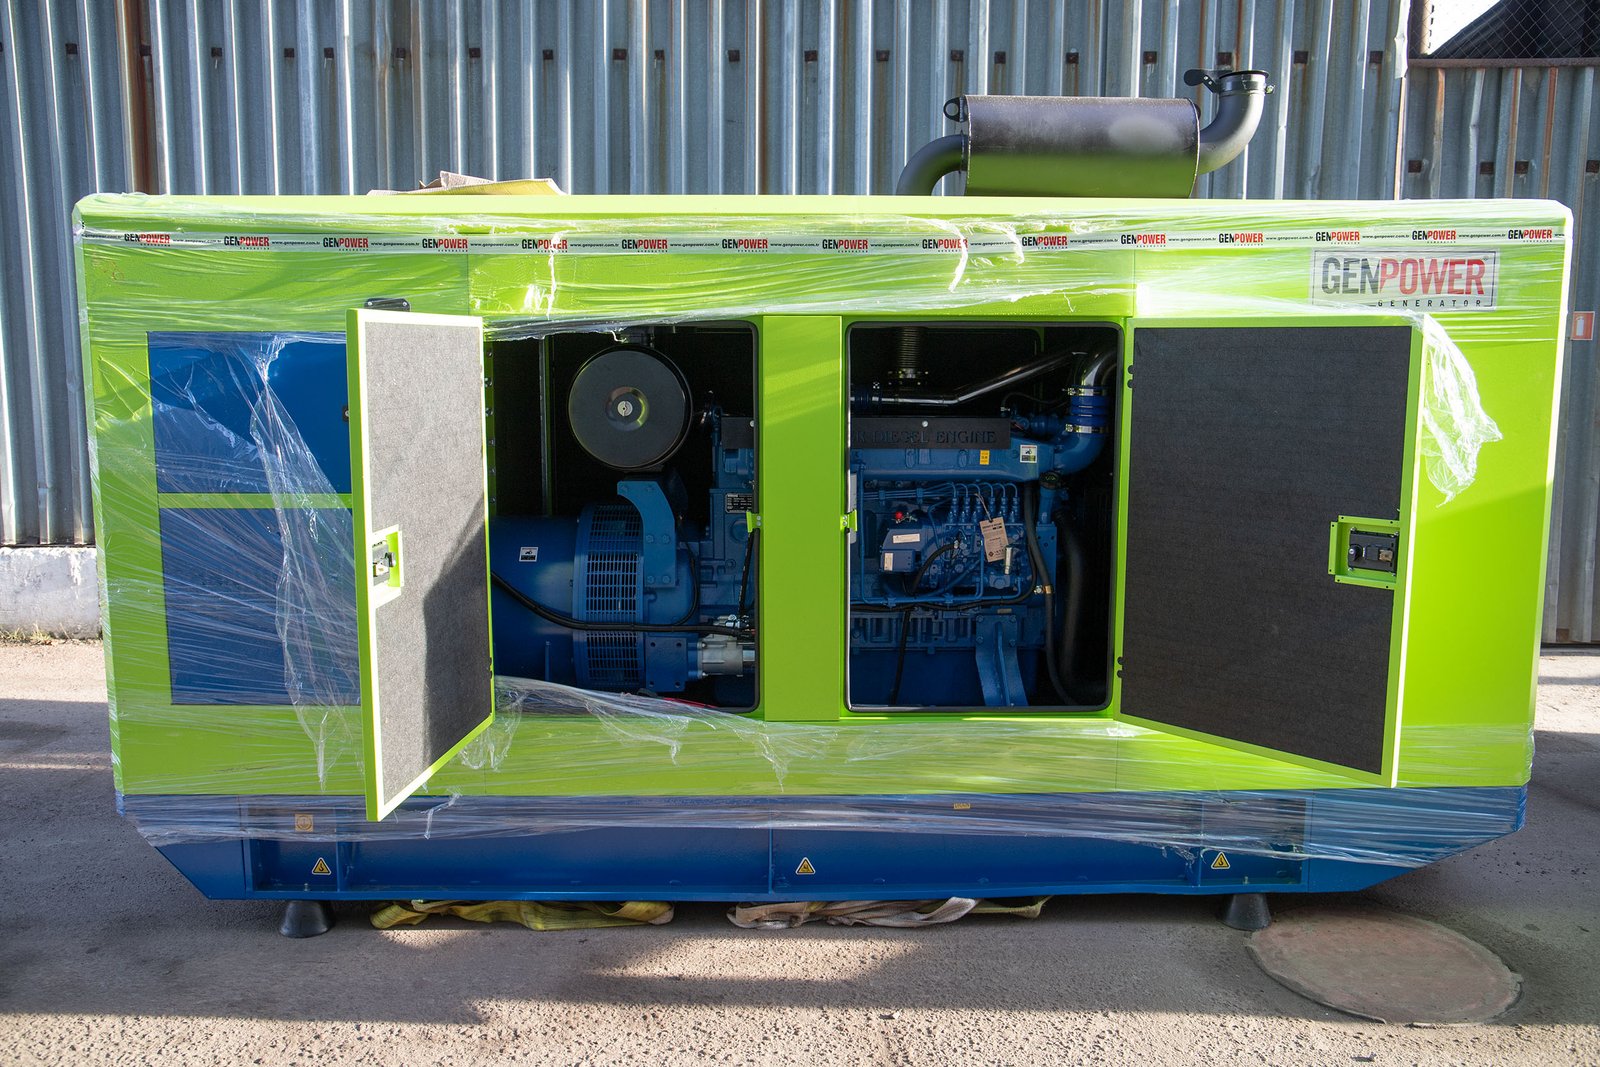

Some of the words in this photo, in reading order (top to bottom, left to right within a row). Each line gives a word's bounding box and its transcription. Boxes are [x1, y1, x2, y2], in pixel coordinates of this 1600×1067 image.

[124, 233, 171, 244] GENPOWER
[223, 236, 270, 247] GENPOWER
[323, 237, 369, 248] GENPOWER
[422, 238, 468, 249] GENPOWER
[621, 239, 668, 250] GENPOWER
[722, 239, 768, 249] GENPOWER
[822, 239, 868, 250] GENPOWER
[1021, 236, 1068, 247] GENPOWER
[1120, 234, 1166, 245] GENPOWER
[1218, 233, 1264, 243] GENPOWER
[1315, 232, 1360, 242] GENPOWER
[1412, 230, 1456, 241] GENPOWER
[1507, 229, 1553, 240] GENPOWER
[1321, 257, 1486, 295] GENPOWER
[1377, 299, 1481, 307] GENERATOR
[872, 431, 930, 444] DIESEL
[936, 431, 997, 444] ENGINE
